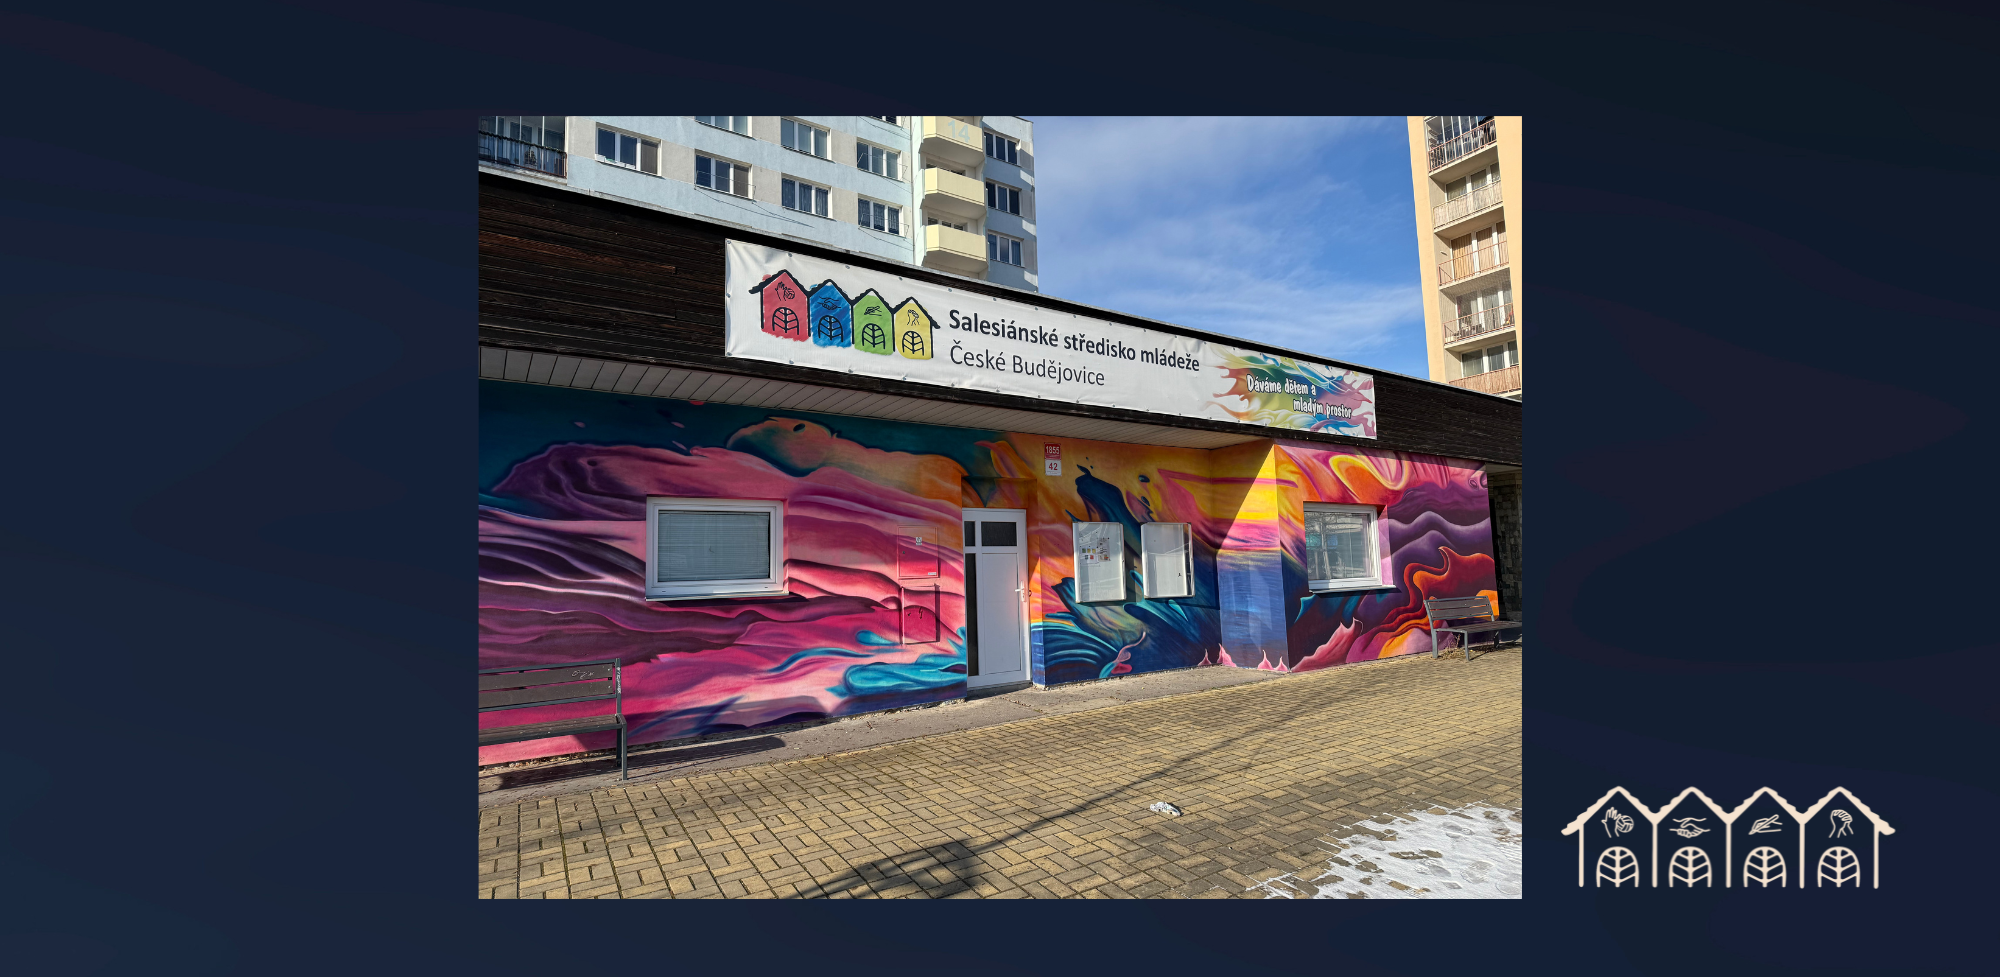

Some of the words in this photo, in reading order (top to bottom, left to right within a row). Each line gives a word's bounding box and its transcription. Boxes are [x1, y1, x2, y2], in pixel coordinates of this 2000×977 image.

[948, 119, 970, 143] 14
[949, 309, 1059, 347] Salesiánské
[1063, 333, 1136, 361] středisko
[1140, 347, 1200, 372] mládeže
[950, 339, 1006, 371] České
[1012, 355, 1105, 386] Budějovice
[1246, 374, 1282, 393] Dáváme
[1284, 378, 1309, 395] dětem
[1311, 385, 1316, 395] a
[1293, 397, 1324, 418] mladým
[1326, 402, 1352, 419] prostor
[1045, 446, 1059, 454] 1855
[1049, 462, 1058, 470] 42
